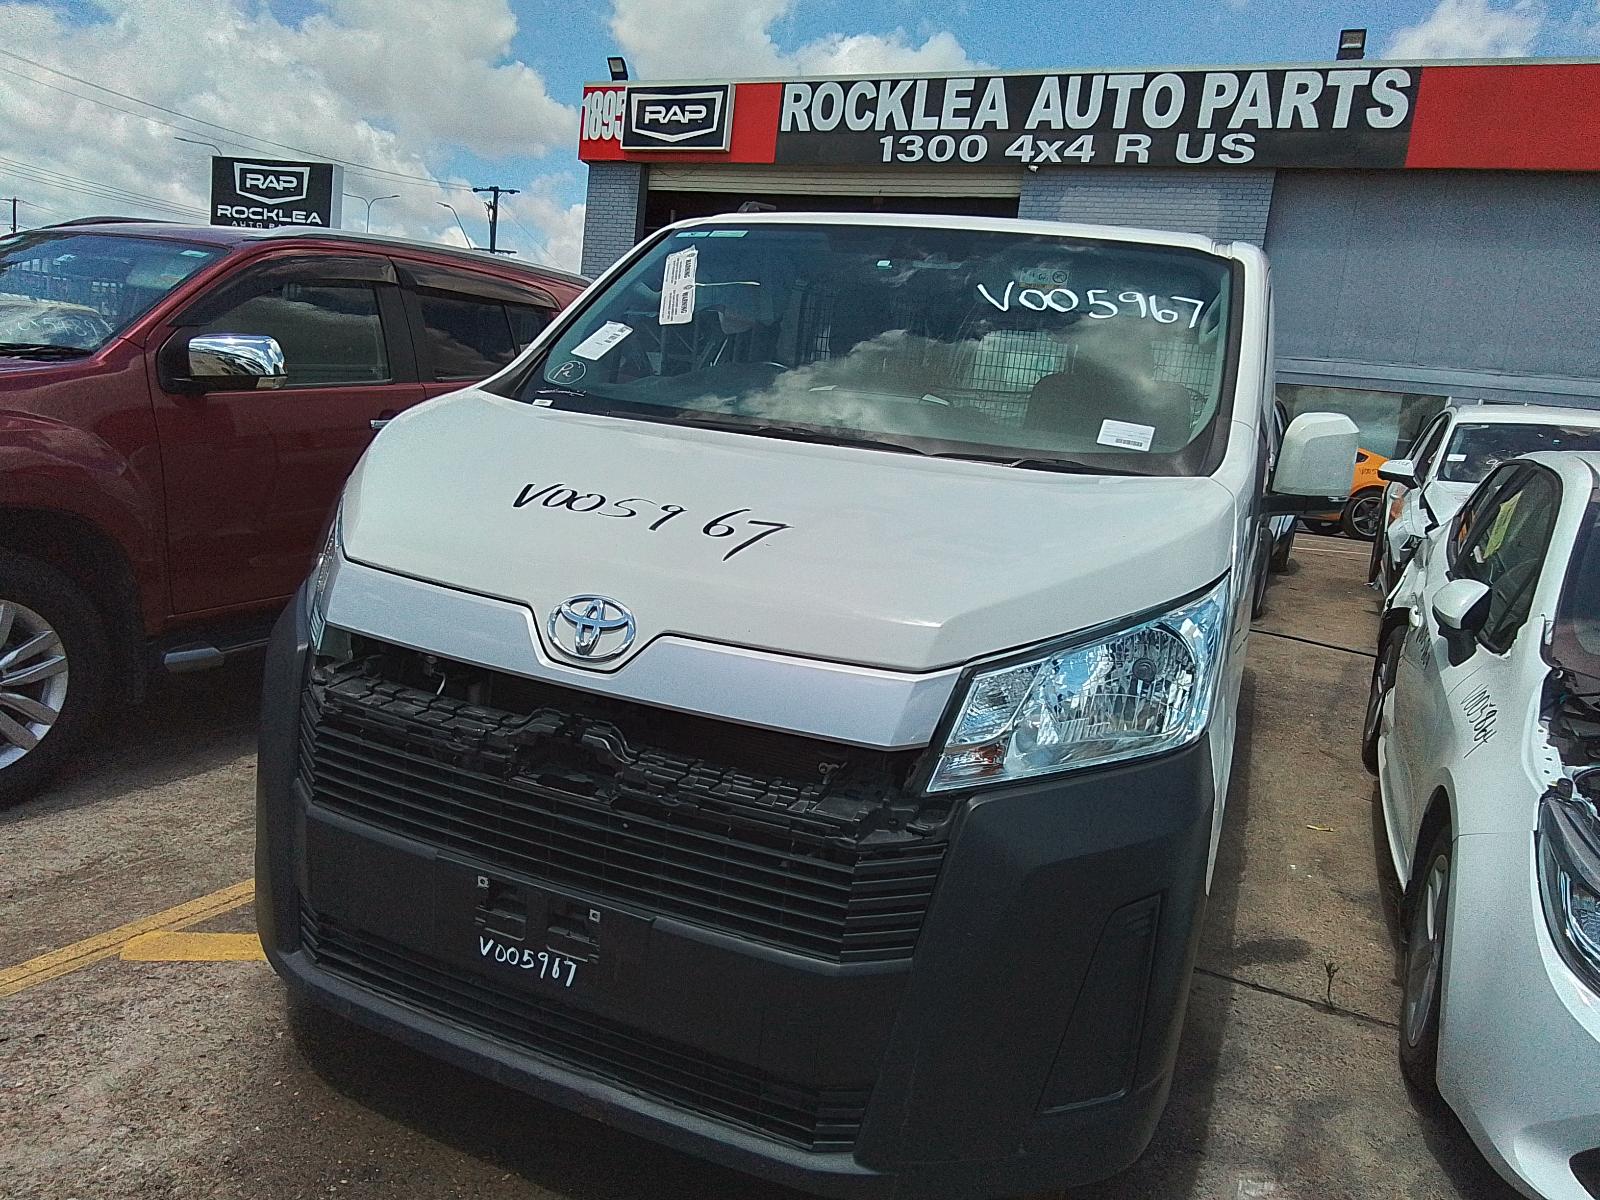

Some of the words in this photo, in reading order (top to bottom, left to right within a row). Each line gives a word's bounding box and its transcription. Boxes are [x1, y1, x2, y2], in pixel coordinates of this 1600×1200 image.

[780, 77, 1009, 132] ROCKLEA
[1024, 73, 1186, 130] AUTO
[1197, 68, 1412, 129] PARTS
[644, 105, 707, 124] RAP
[879, 134, 988, 163] 1300
[1004, 134, 1096, 163] 4x4
[1114, 133, 1152, 163] R
[1175, 132, 1256, 164] US
[245, 173, 298, 191] RAP
[216, 204, 323, 225] ROCKLEA
[680, 291, 689, 314] WARNING
[977, 280, 1205, 329] V005967
[479, 935, 577, 987] V005967
